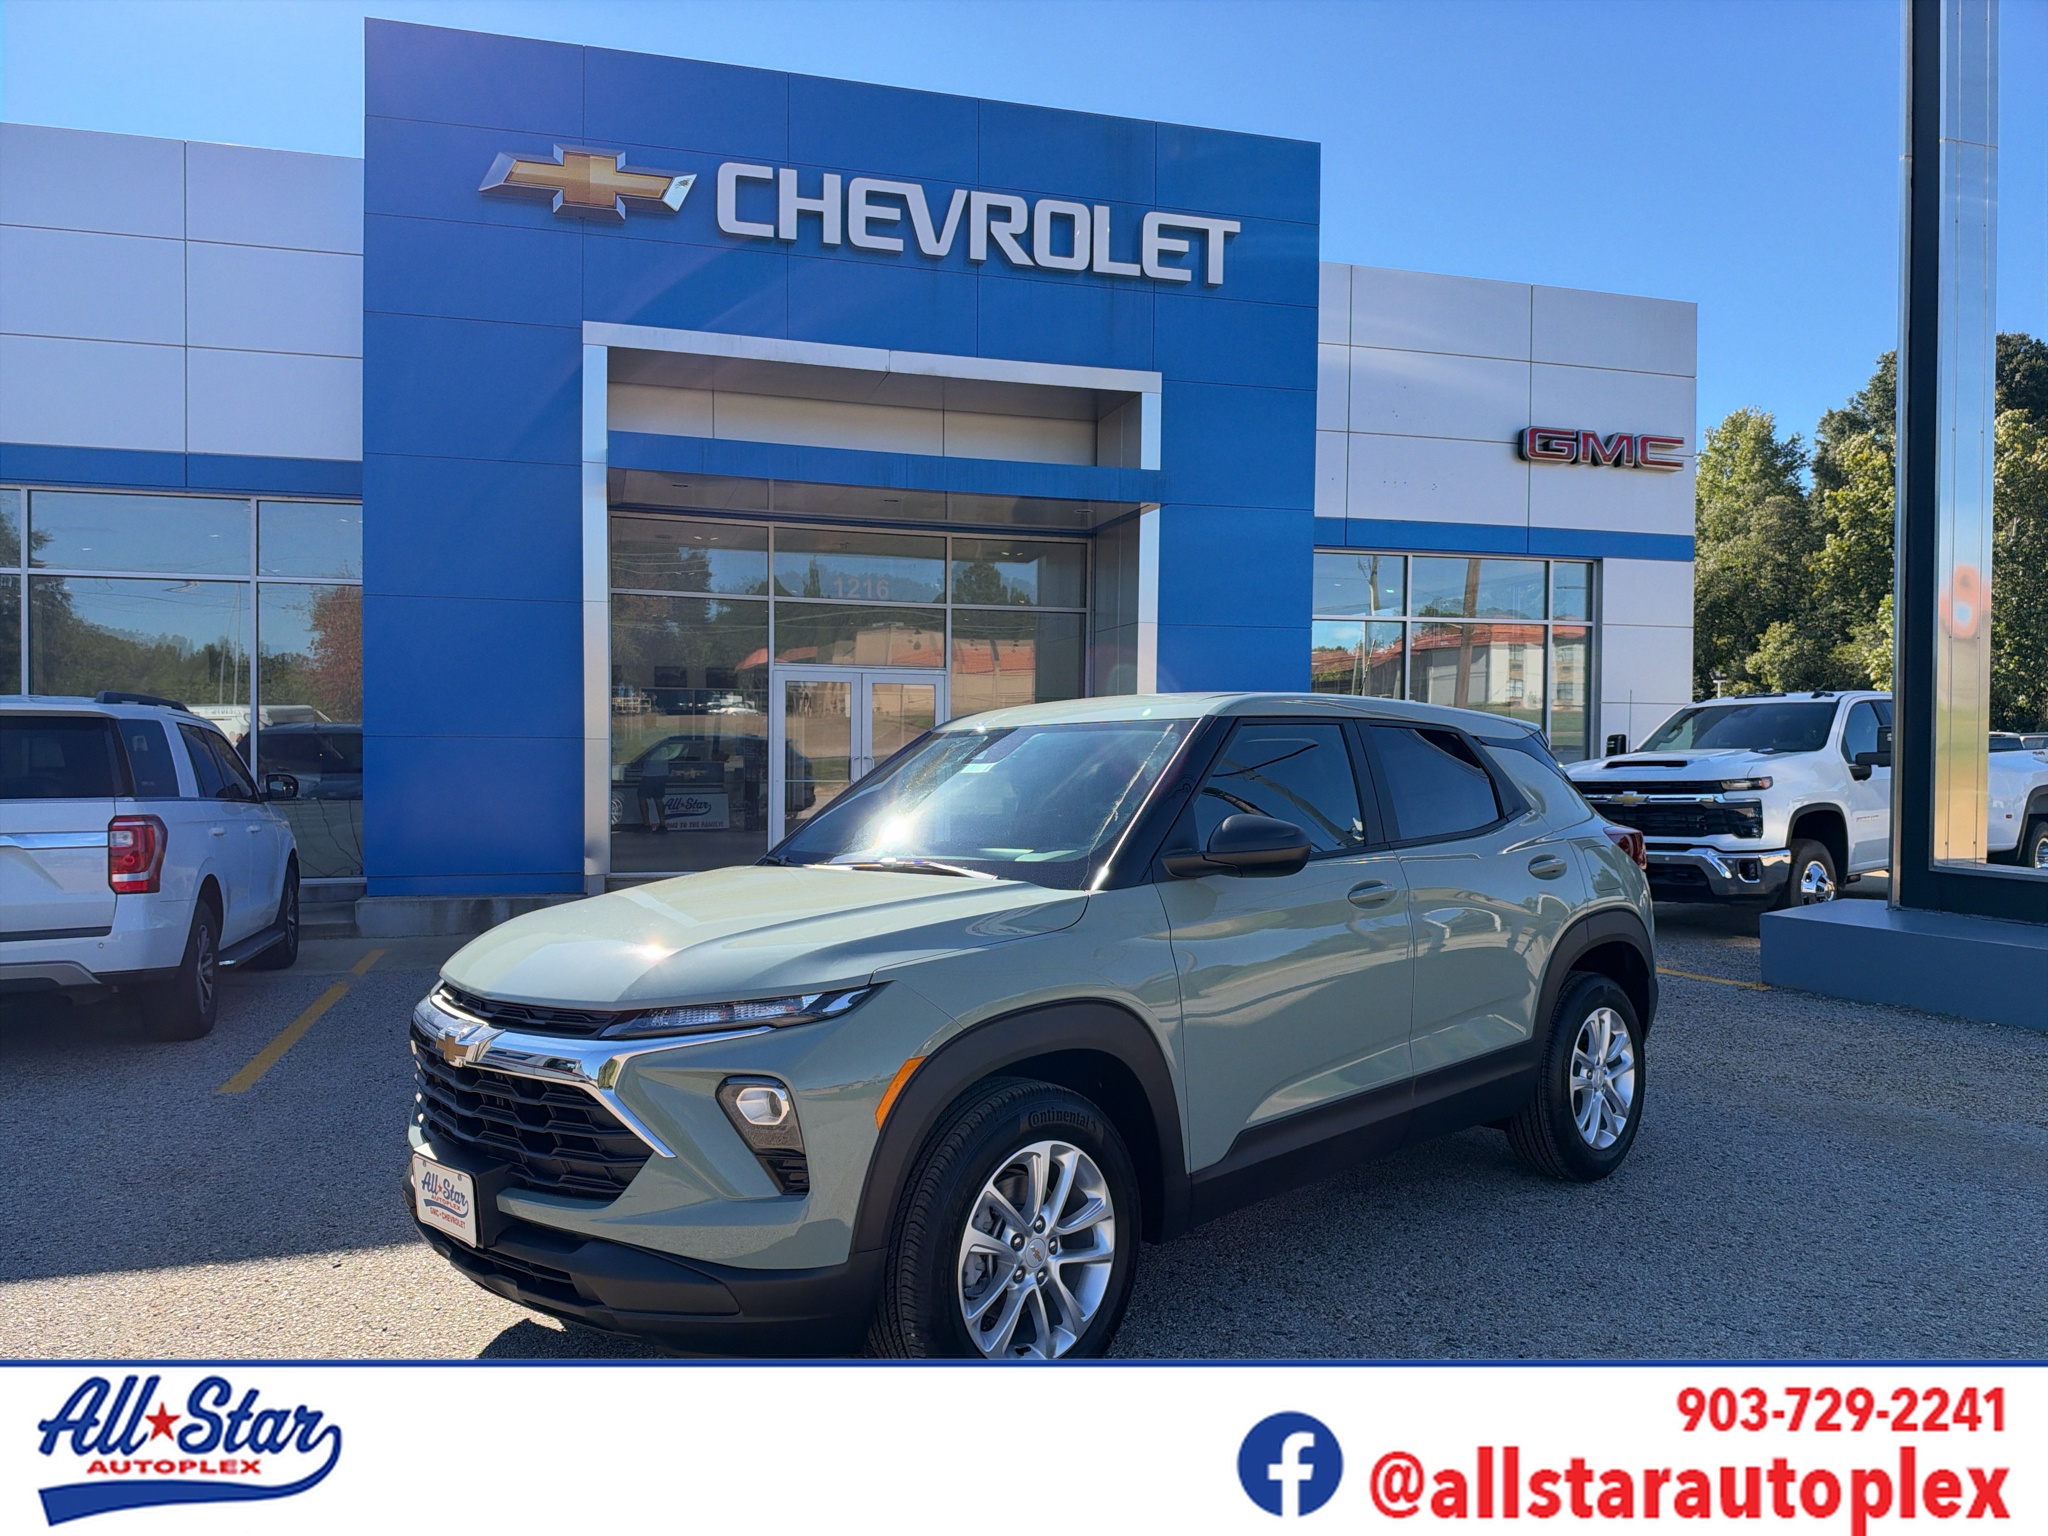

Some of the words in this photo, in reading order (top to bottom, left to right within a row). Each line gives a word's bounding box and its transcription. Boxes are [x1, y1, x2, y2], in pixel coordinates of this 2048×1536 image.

[717, 161, 1241, 287] CHEVROLET
[1518, 426, 1684, 471] GMC
[833, 577, 889, 599] 1216
[685, 798, 709, 810] Star
[1028, 1107, 1089, 1129] Continental
[431, 1194, 461, 1211] AUTOPLEX
